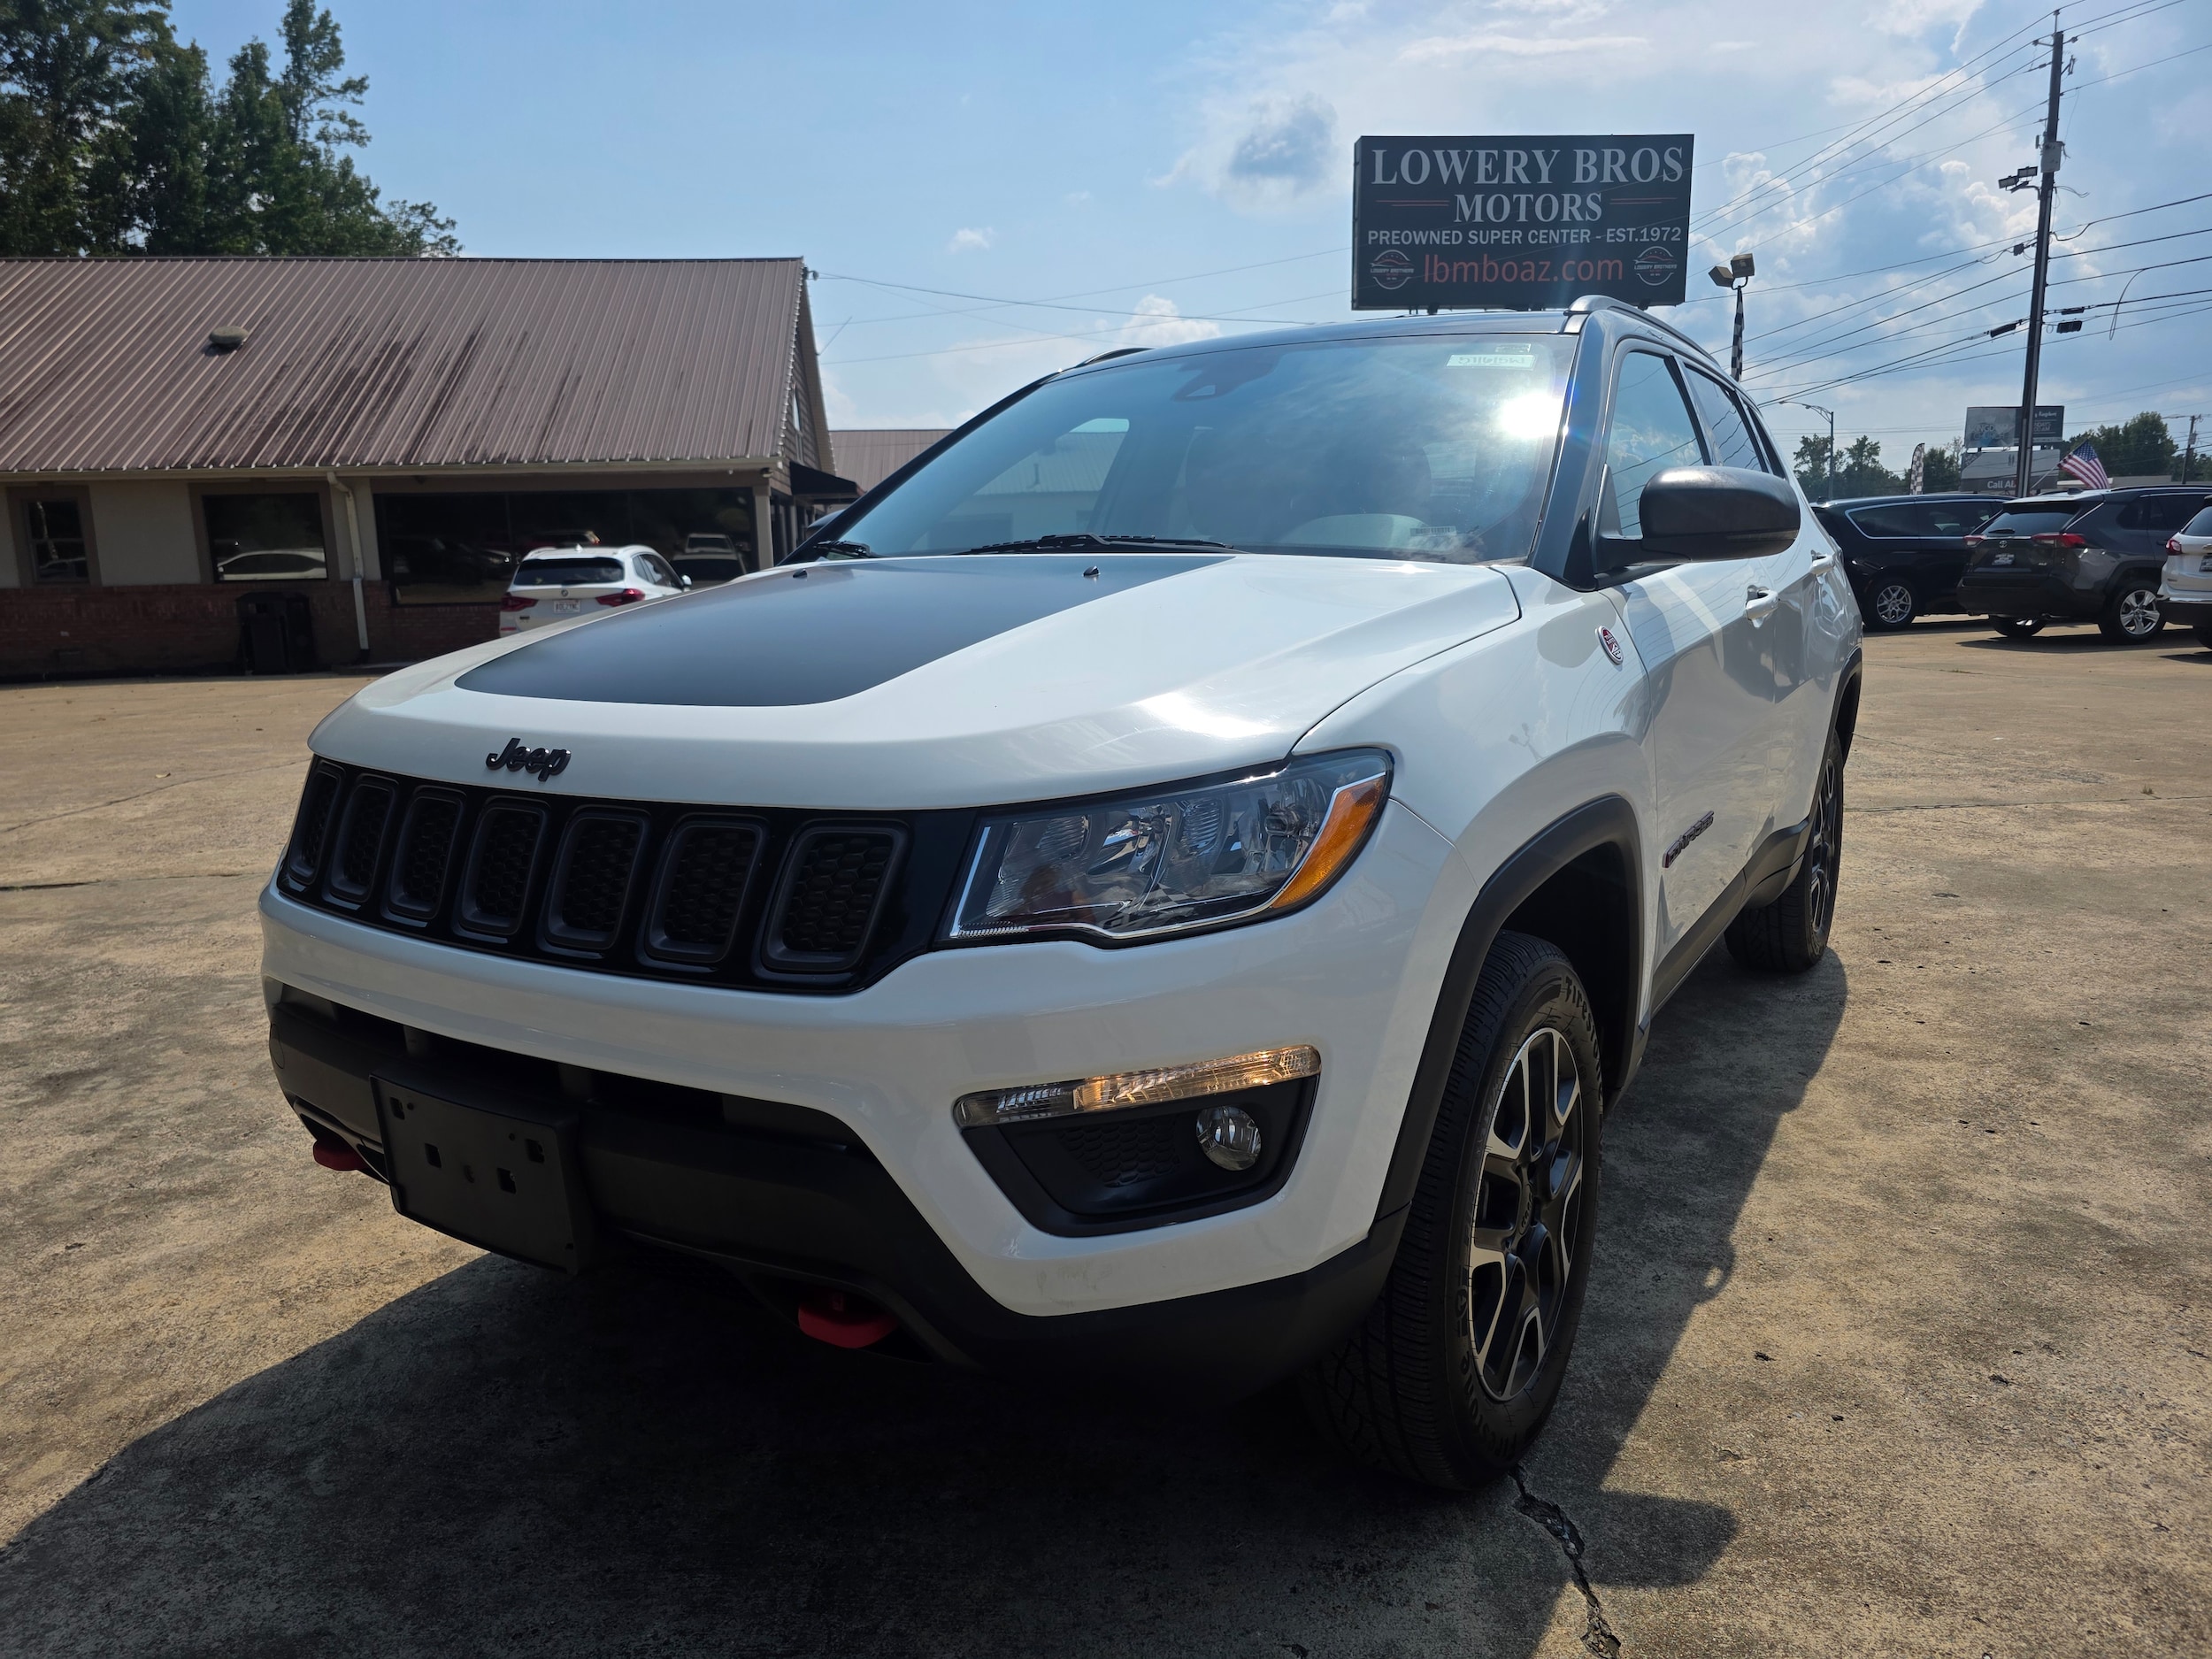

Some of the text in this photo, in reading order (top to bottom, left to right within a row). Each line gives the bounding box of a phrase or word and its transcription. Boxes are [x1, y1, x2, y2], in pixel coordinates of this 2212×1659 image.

[1371, 146, 1684, 185] LOWERY BROS
[1454, 192, 1603, 223] MOTORS
[1368, 229, 1463, 246] PREOWNED
[1468, 229, 1523, 245] SUPER
[1528, 227, 1591, 244] CENTER
[1606, 227, 1681, 243] EST.1972
[1424, 253, 1624, 283] lbmboaz.com
[1987, 480, 2004, 488] Call
[486, 737, 572, 782] Jeep
